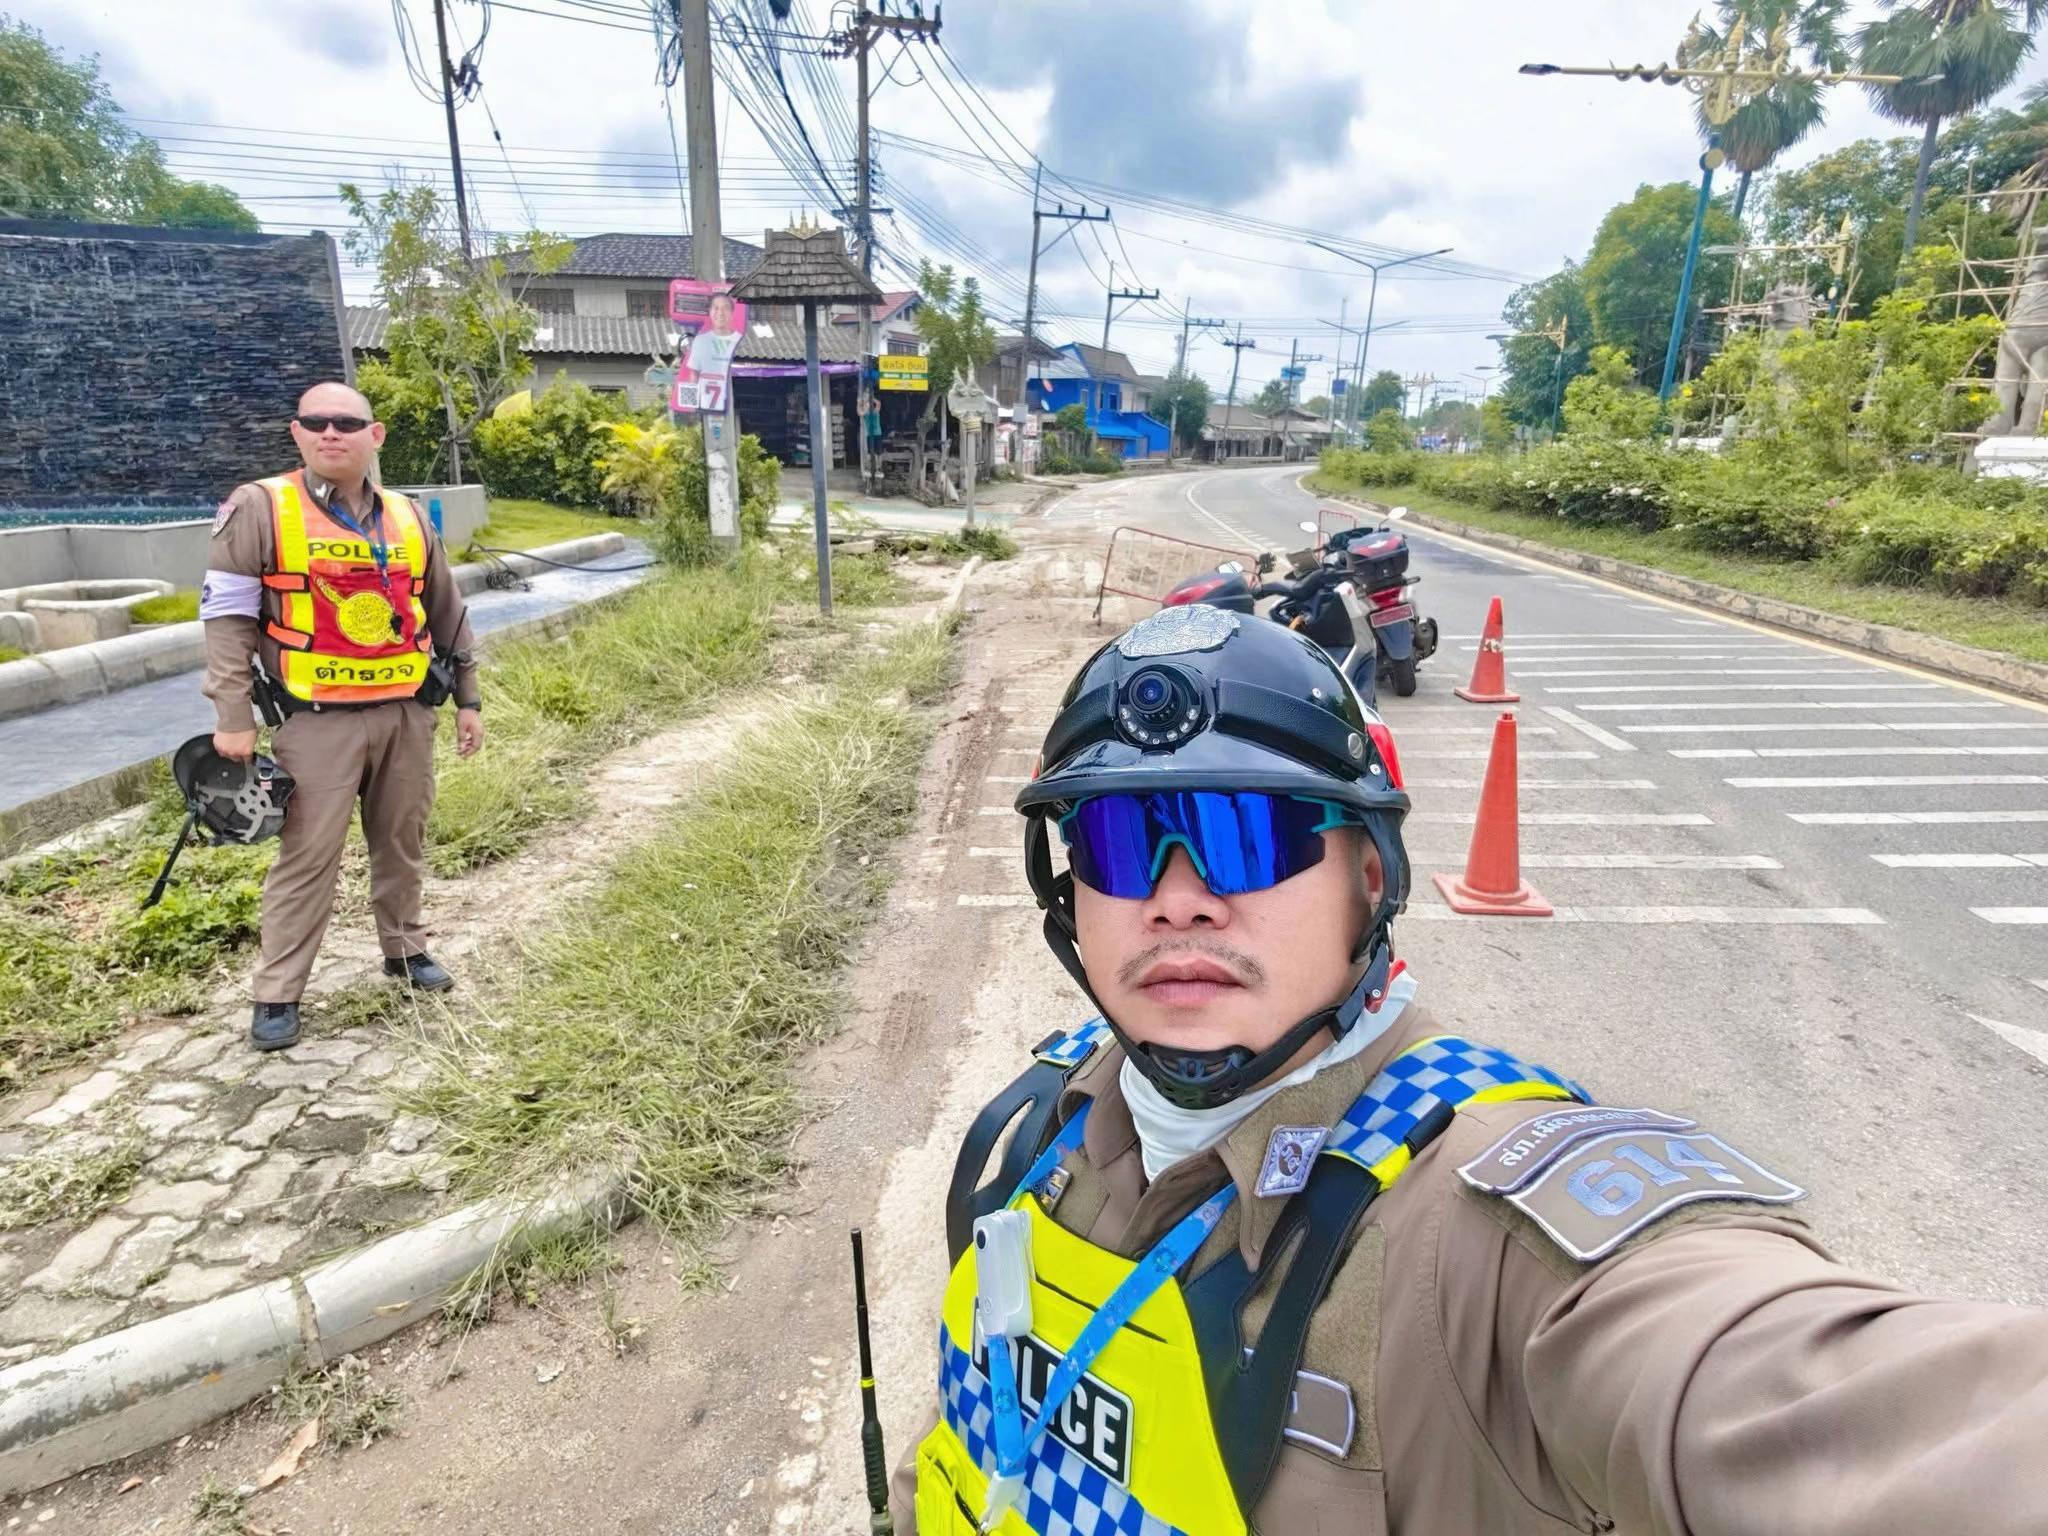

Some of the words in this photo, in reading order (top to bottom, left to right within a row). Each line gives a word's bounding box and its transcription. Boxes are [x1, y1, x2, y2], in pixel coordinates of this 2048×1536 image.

[705, 385, 721, 408] 7
[315, 661, 415, 681] ตำรวจ
[1567, 1140, 1744, 1216] 614
